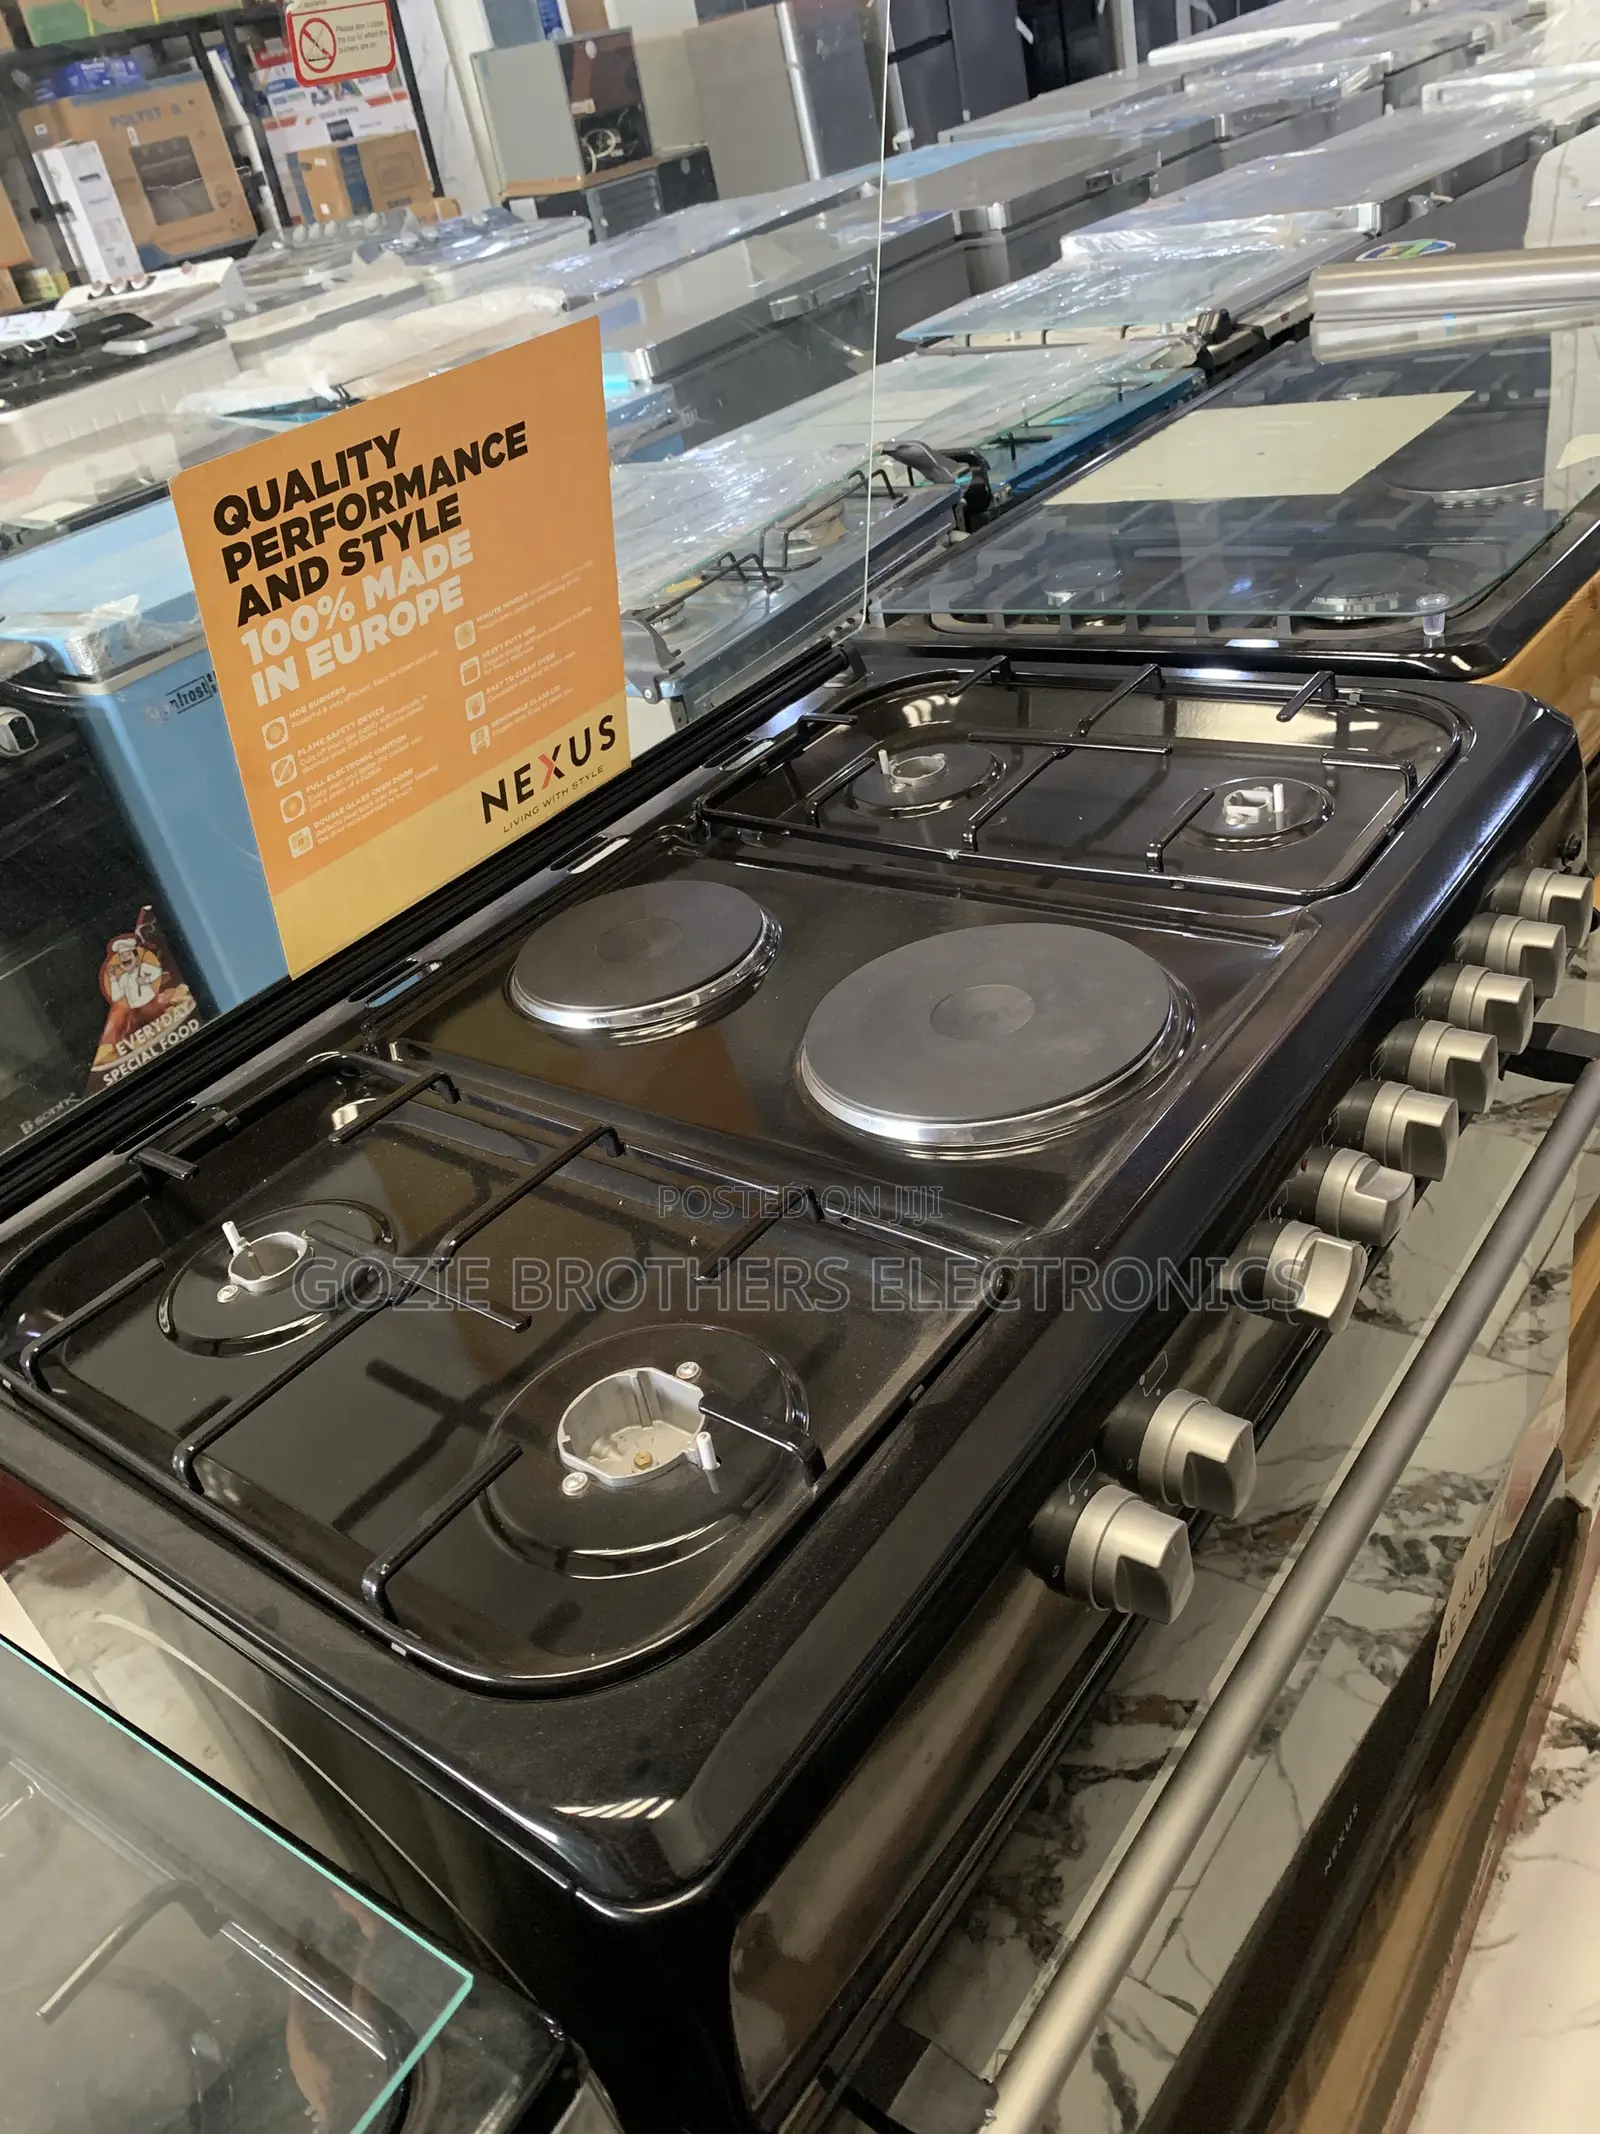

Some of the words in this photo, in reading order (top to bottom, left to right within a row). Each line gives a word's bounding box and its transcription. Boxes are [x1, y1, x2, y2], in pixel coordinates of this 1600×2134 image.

[214, 428, 400, 535] QUALITY
[222, 421, 528, 584] PERFORMANCE
[238, 556, 329, 627] AND
[339, 493, 462, 576] STYLE
[240, 587, 355, 665] 100%
[362, 529, 474, 610] MADE
[477, 605, 500, 622] MINUTE
[251, 656, 299, 708] IN
[306, 575, 464, 680] EUROPE
[482, 643, 502, 658] HEAVY
[505, 633, 521, 646] DUTY
[289, 705, 305, 718] HOB
[309, 685, 344, 708] BURNERS
[374, 675, 387, 686] Easy
[398, 662, 413, 674] clean
[487, 680, 502, 693] EASY
[506, 675, 512, 683] TO
[516, 662, 535, 678] CLEAN
[538, 652, 554, 666] OVEN
[297, 737, 323, 756] FLAME
[327, 721, 355, 740] SAFETY
[358, 706, 384, 724] DEVICE
[306, 778, 323, 792] FULL
[327, 752, 371, 781] ELECTRONIC
[375, 734, 405, 755] IGNITION
[481, 715, 615, 824] NEXUS
[314, 807, 343, 828] DOUBLE
[346, 793, 368, 810] GLASS
[372, 781, 390, 795] OVEN
[393, 769, 412, 783] DOOR
[503, 806, 540, 833] LIVING
[542, 788, 570, 808] WITH
[572, 765, 604, 790] STYLE
[103, 1042, 158, 1086] SPECIAL
[160, 1018, 200, 1051] FOOD
[115, 1001, 196, 1057] EVERYDAY
